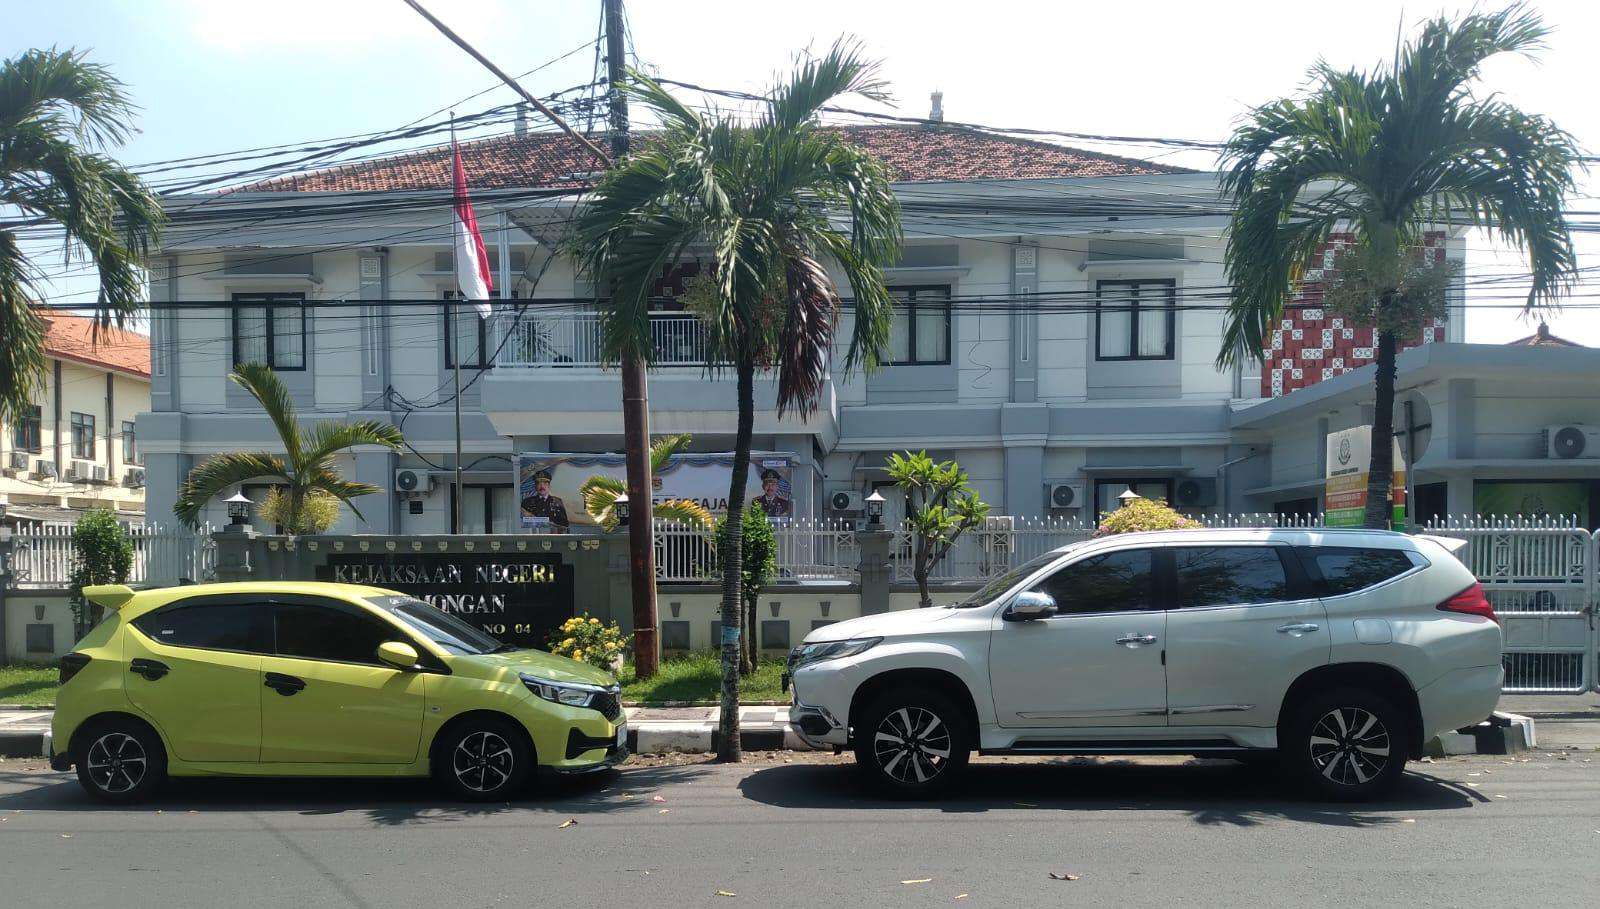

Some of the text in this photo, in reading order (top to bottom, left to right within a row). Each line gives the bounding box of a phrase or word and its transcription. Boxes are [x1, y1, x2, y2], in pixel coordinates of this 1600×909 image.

[333, 563, 555, 584] KEJAKSAAN NEGERI
[415, 594, 506, 614] ONGAN
[483, 623, 532, 635] NO 04
